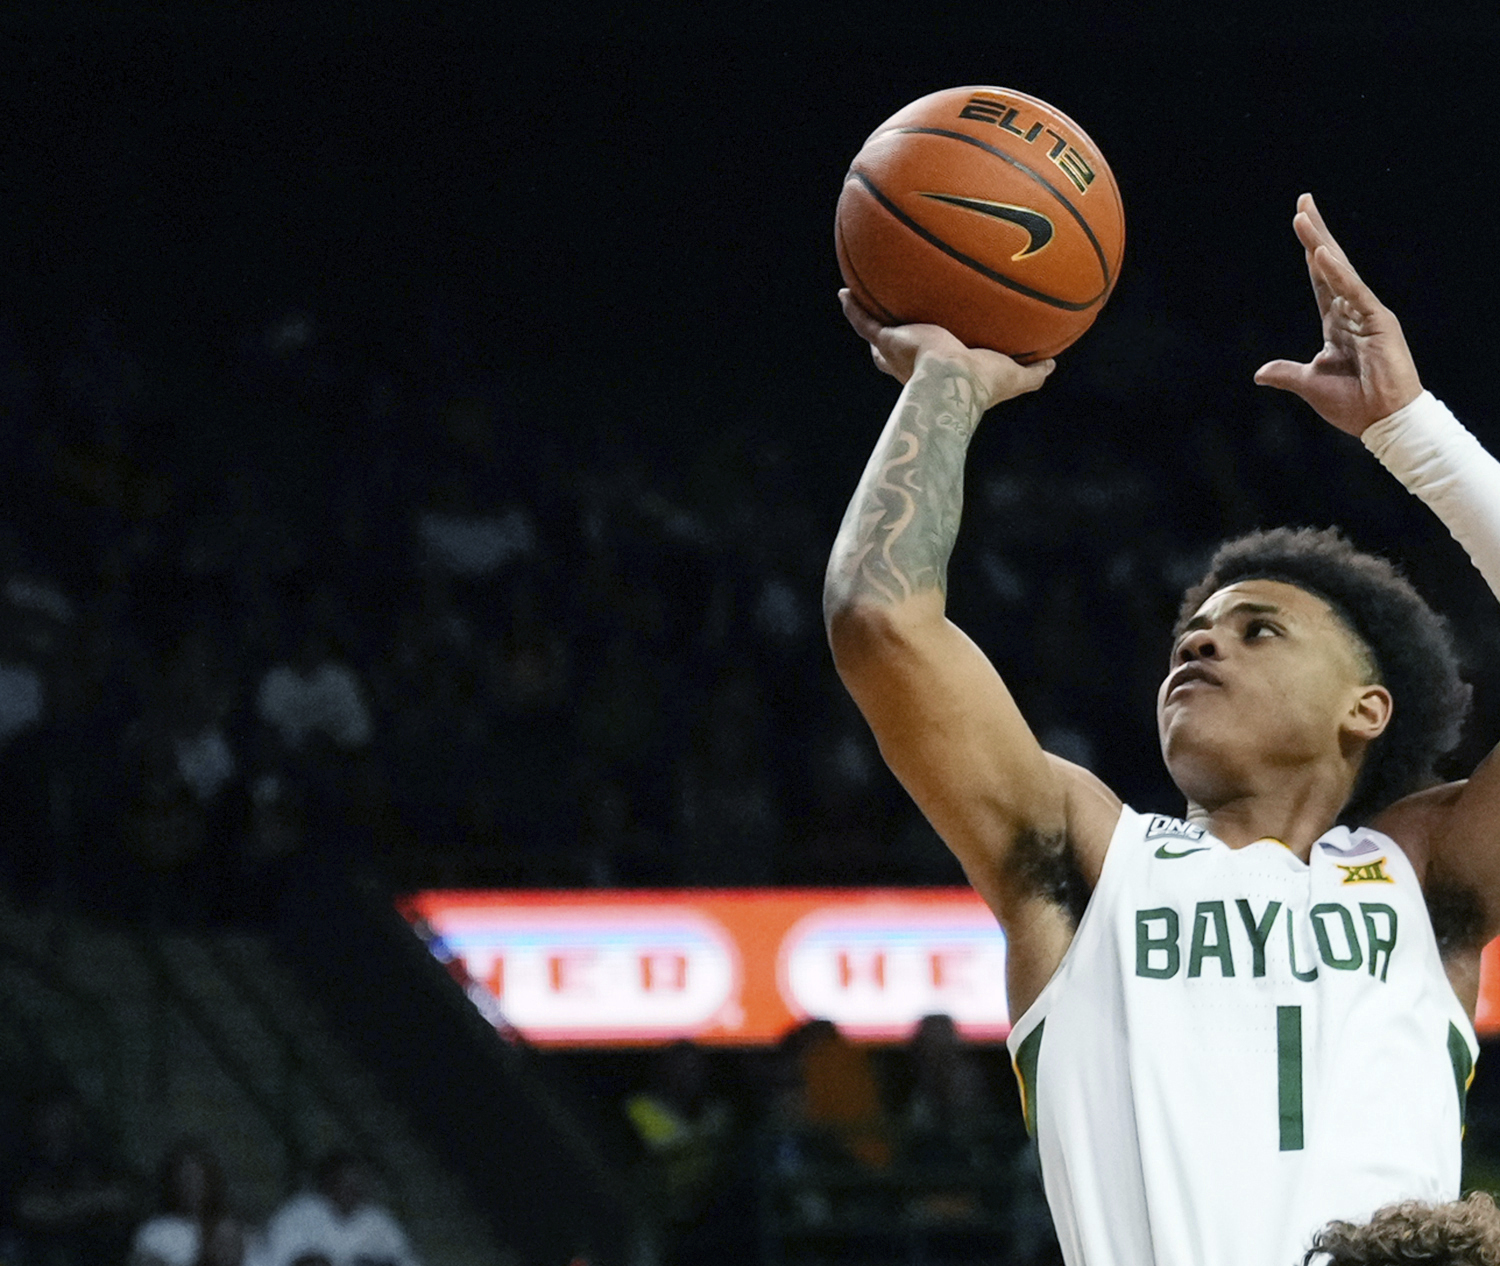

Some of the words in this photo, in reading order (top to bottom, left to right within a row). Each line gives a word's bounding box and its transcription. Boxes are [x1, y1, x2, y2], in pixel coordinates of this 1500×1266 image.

[959, 98, 1095, 195] ELITE
[1135, 899, 1398, 983] BAYLOR
[1277, 1005, 1304, 1151] 1
